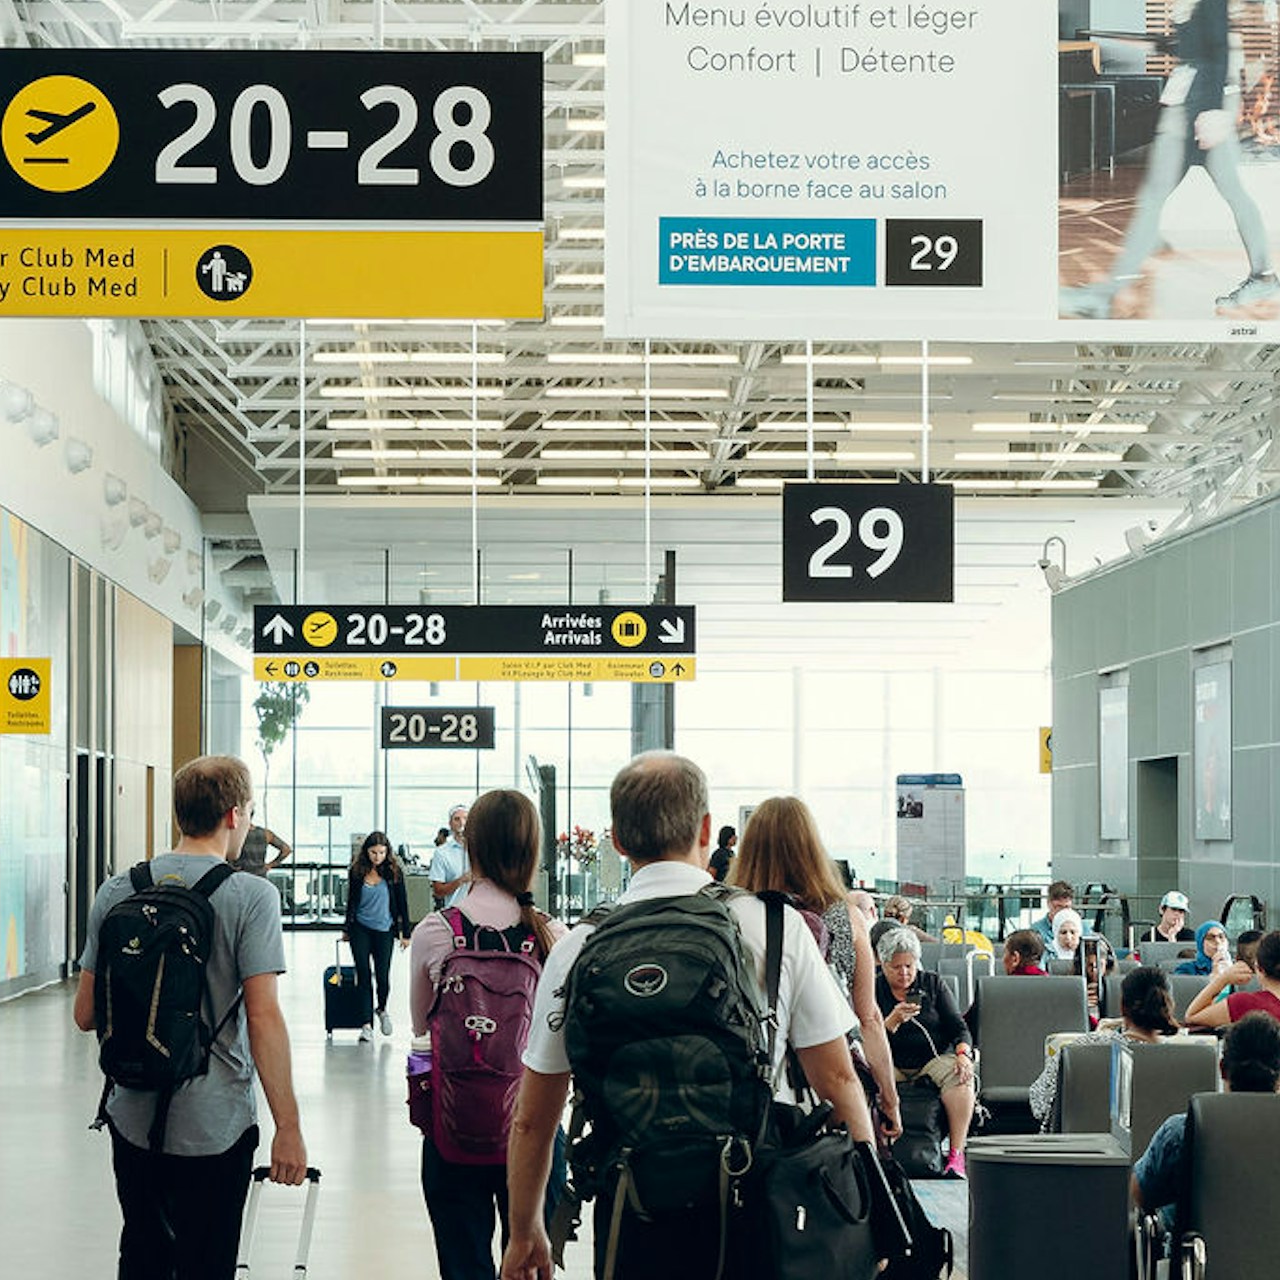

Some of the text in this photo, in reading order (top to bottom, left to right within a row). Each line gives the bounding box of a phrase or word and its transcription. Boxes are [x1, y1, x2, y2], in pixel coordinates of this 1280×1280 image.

[665, 1, 979, 35] Menu évolutif et léger
[686, 46, 955, 74] Confort Détente
[154, 82, 496, 187] 20-28
[711, 148, 931, 172] Achetez votre accès
[694, 177, 948, 200] à la borne face au salon
[669, 229, 846, 251] PRÈS DE LA PORTE
[19, 246, 75, 269] Club
[85, 247, 136, 269] Med
[669, 254, 851, 274] D'EMBARQUEMENT
[908, 234, 959, 272] 29
[22, 275, 77, 297] Club
[88, 276, 138, 297] Med
[806, 507, 904, 580] 29
[345, 613, 447, 646] 20-28
[541, 613, 603, 629] Arrivées
[543, 630, 603, 646] Arrivals
[389, 713, 479, 743] 20-28
